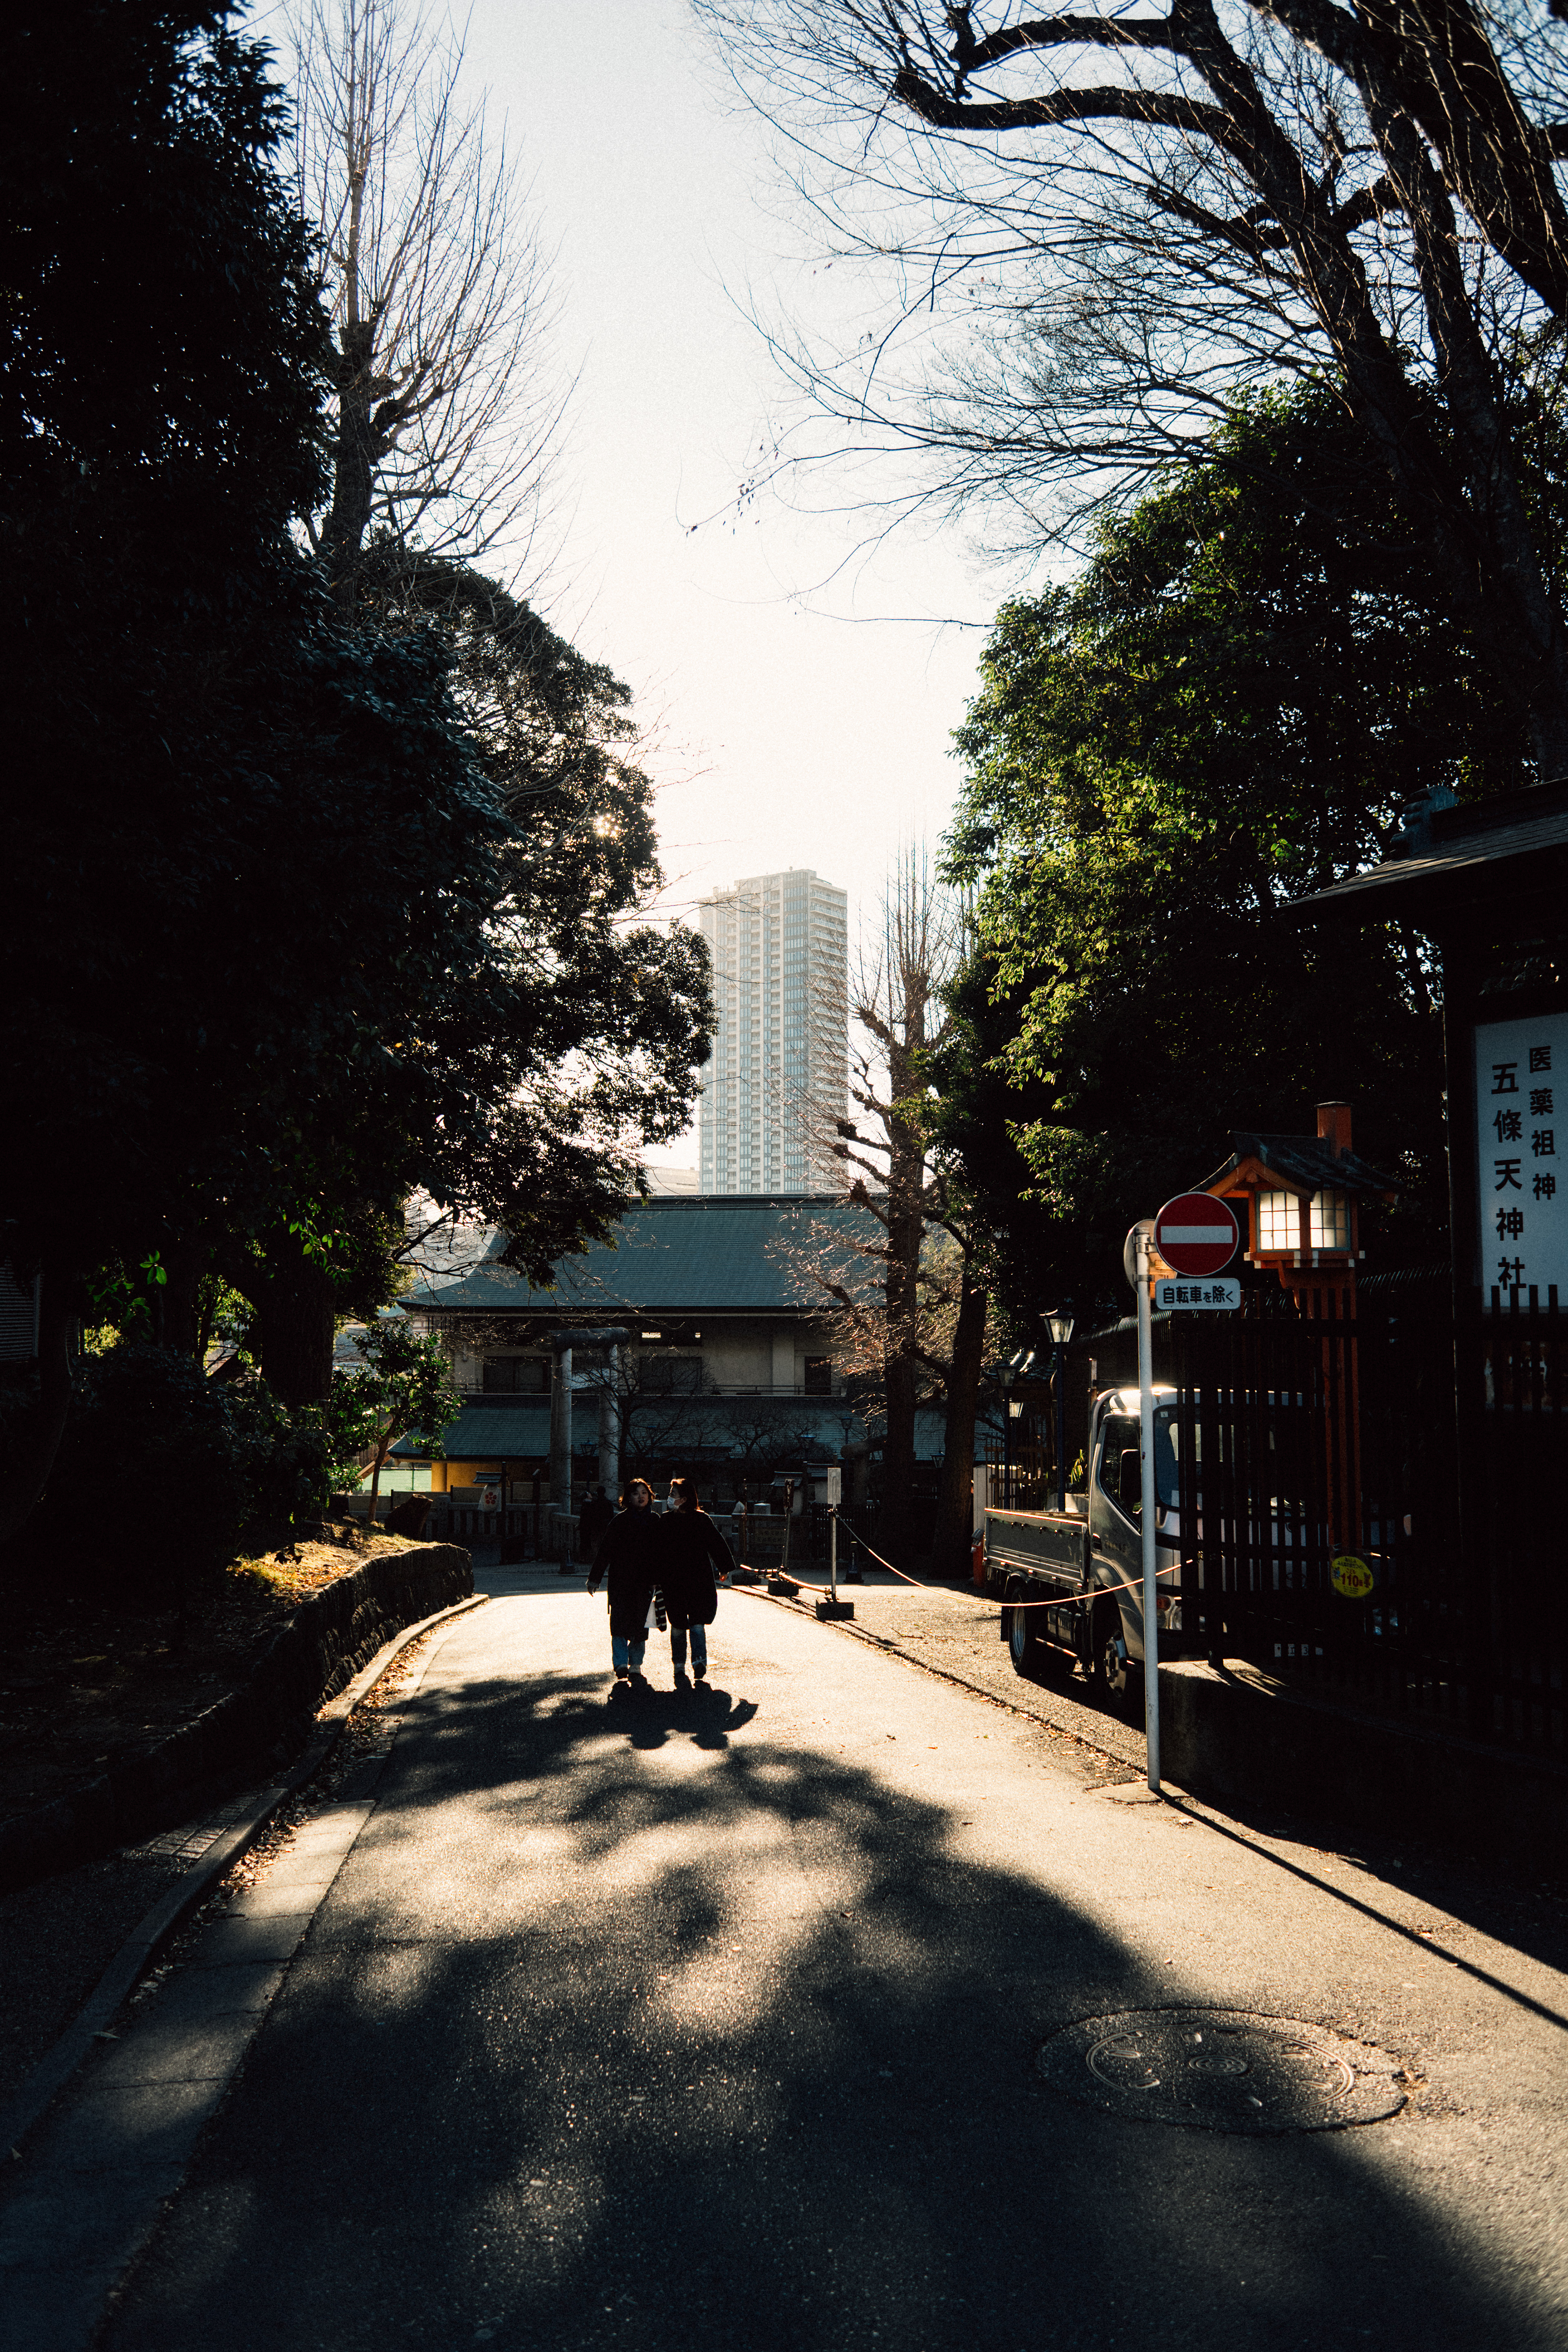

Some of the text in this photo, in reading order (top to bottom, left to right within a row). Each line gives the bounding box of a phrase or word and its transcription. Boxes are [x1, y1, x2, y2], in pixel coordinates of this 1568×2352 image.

[1491, 1062, 1526, 1290] 五條天神社
[1529, 1046, 1556, 1200] 医薬祖神
[1163, 1286, 1233, 1303] 自転車を除く
